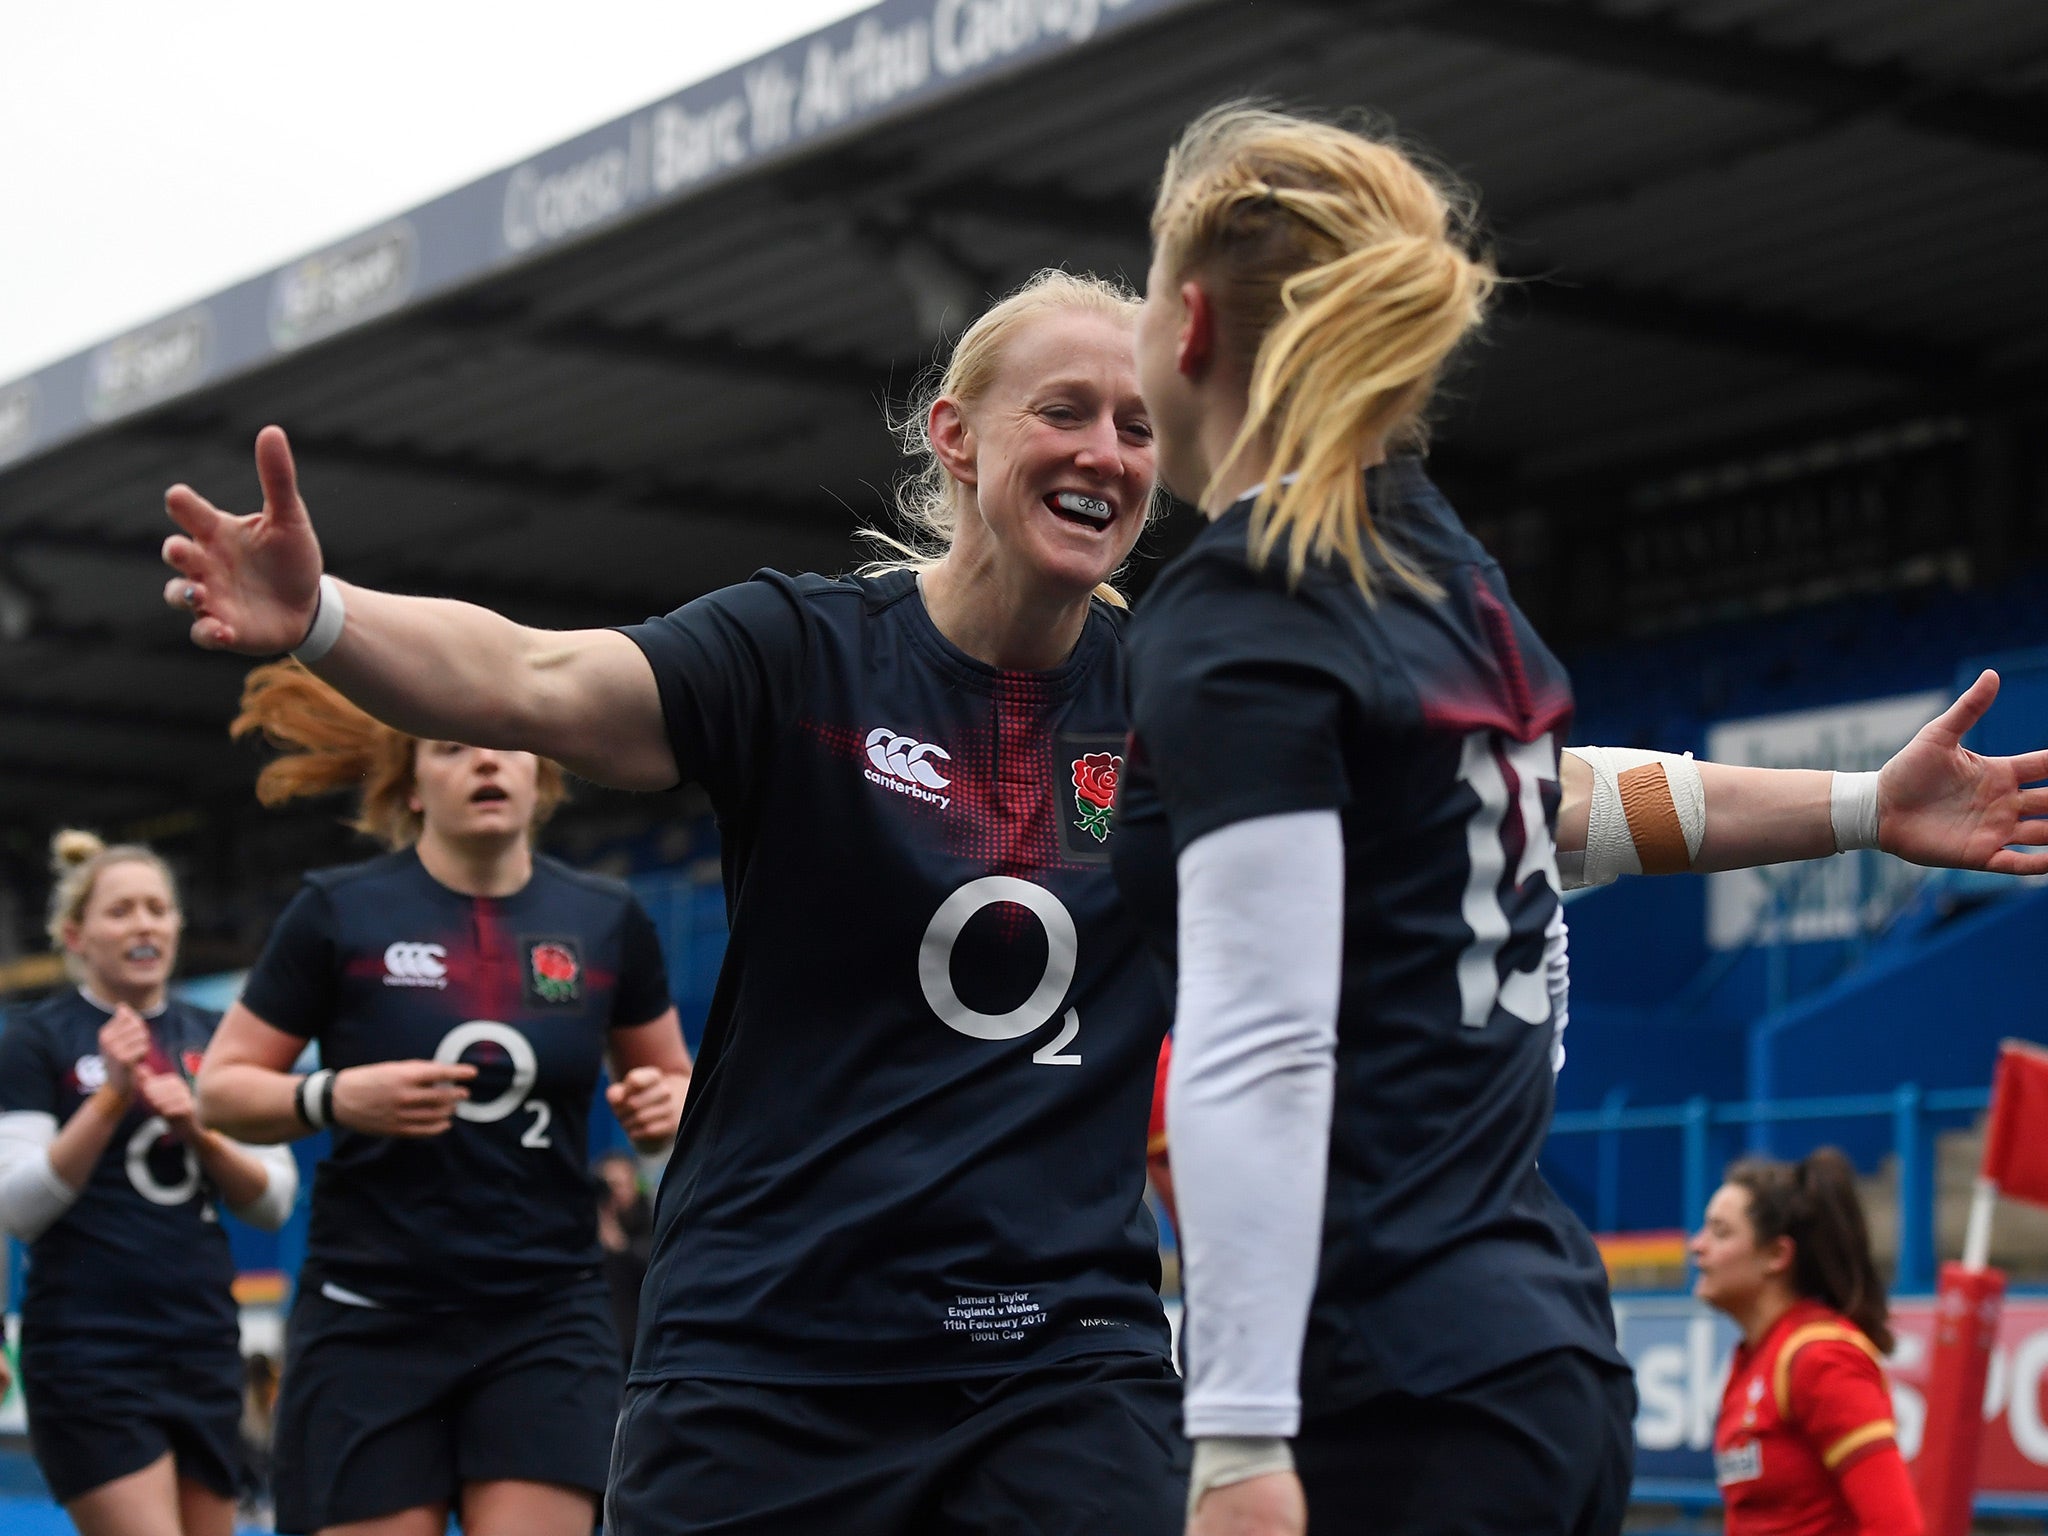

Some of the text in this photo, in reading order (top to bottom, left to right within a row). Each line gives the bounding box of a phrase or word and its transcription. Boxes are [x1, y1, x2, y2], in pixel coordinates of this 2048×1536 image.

[863, 768, 951, 810] canterbury
[1454, 729, 1564, 1029] 15
[918, 875, 1082, 1066] O2
[956, 1292, 1029, 1306] Tamara Taylor
[948, 1302, 1040, 1319] England v Wales
[943, 1312, 1048, 1331] 11th February 2017
[970, 1329, 1025, 1342] 100th Cap
